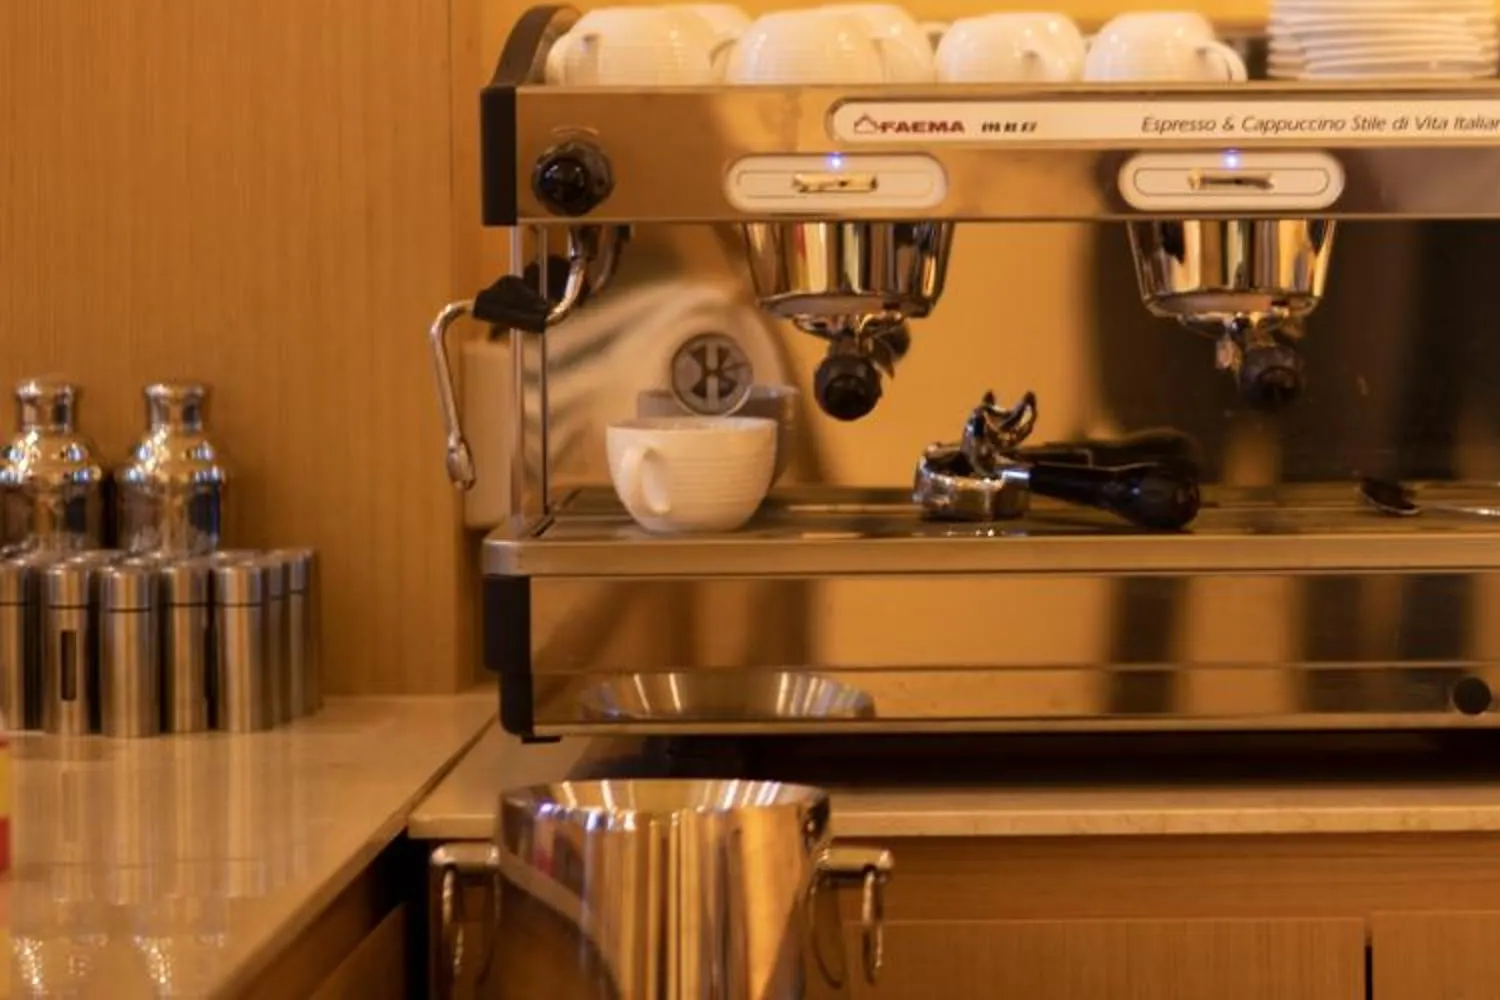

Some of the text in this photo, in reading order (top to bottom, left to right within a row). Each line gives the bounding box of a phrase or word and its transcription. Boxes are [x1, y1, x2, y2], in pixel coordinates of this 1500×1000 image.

[879, 120, 965, 134] FAEMA
[1141, 116, 1216, 135] Espresso
[1222, 118, 1235, 132] &
[1241, 115, 1346, 135] Cappuccino
[1351, 114, 1386, 131] Stile
[1392, 114, 1408, 130] di
[1415, 115, 1448, 131] Vita
